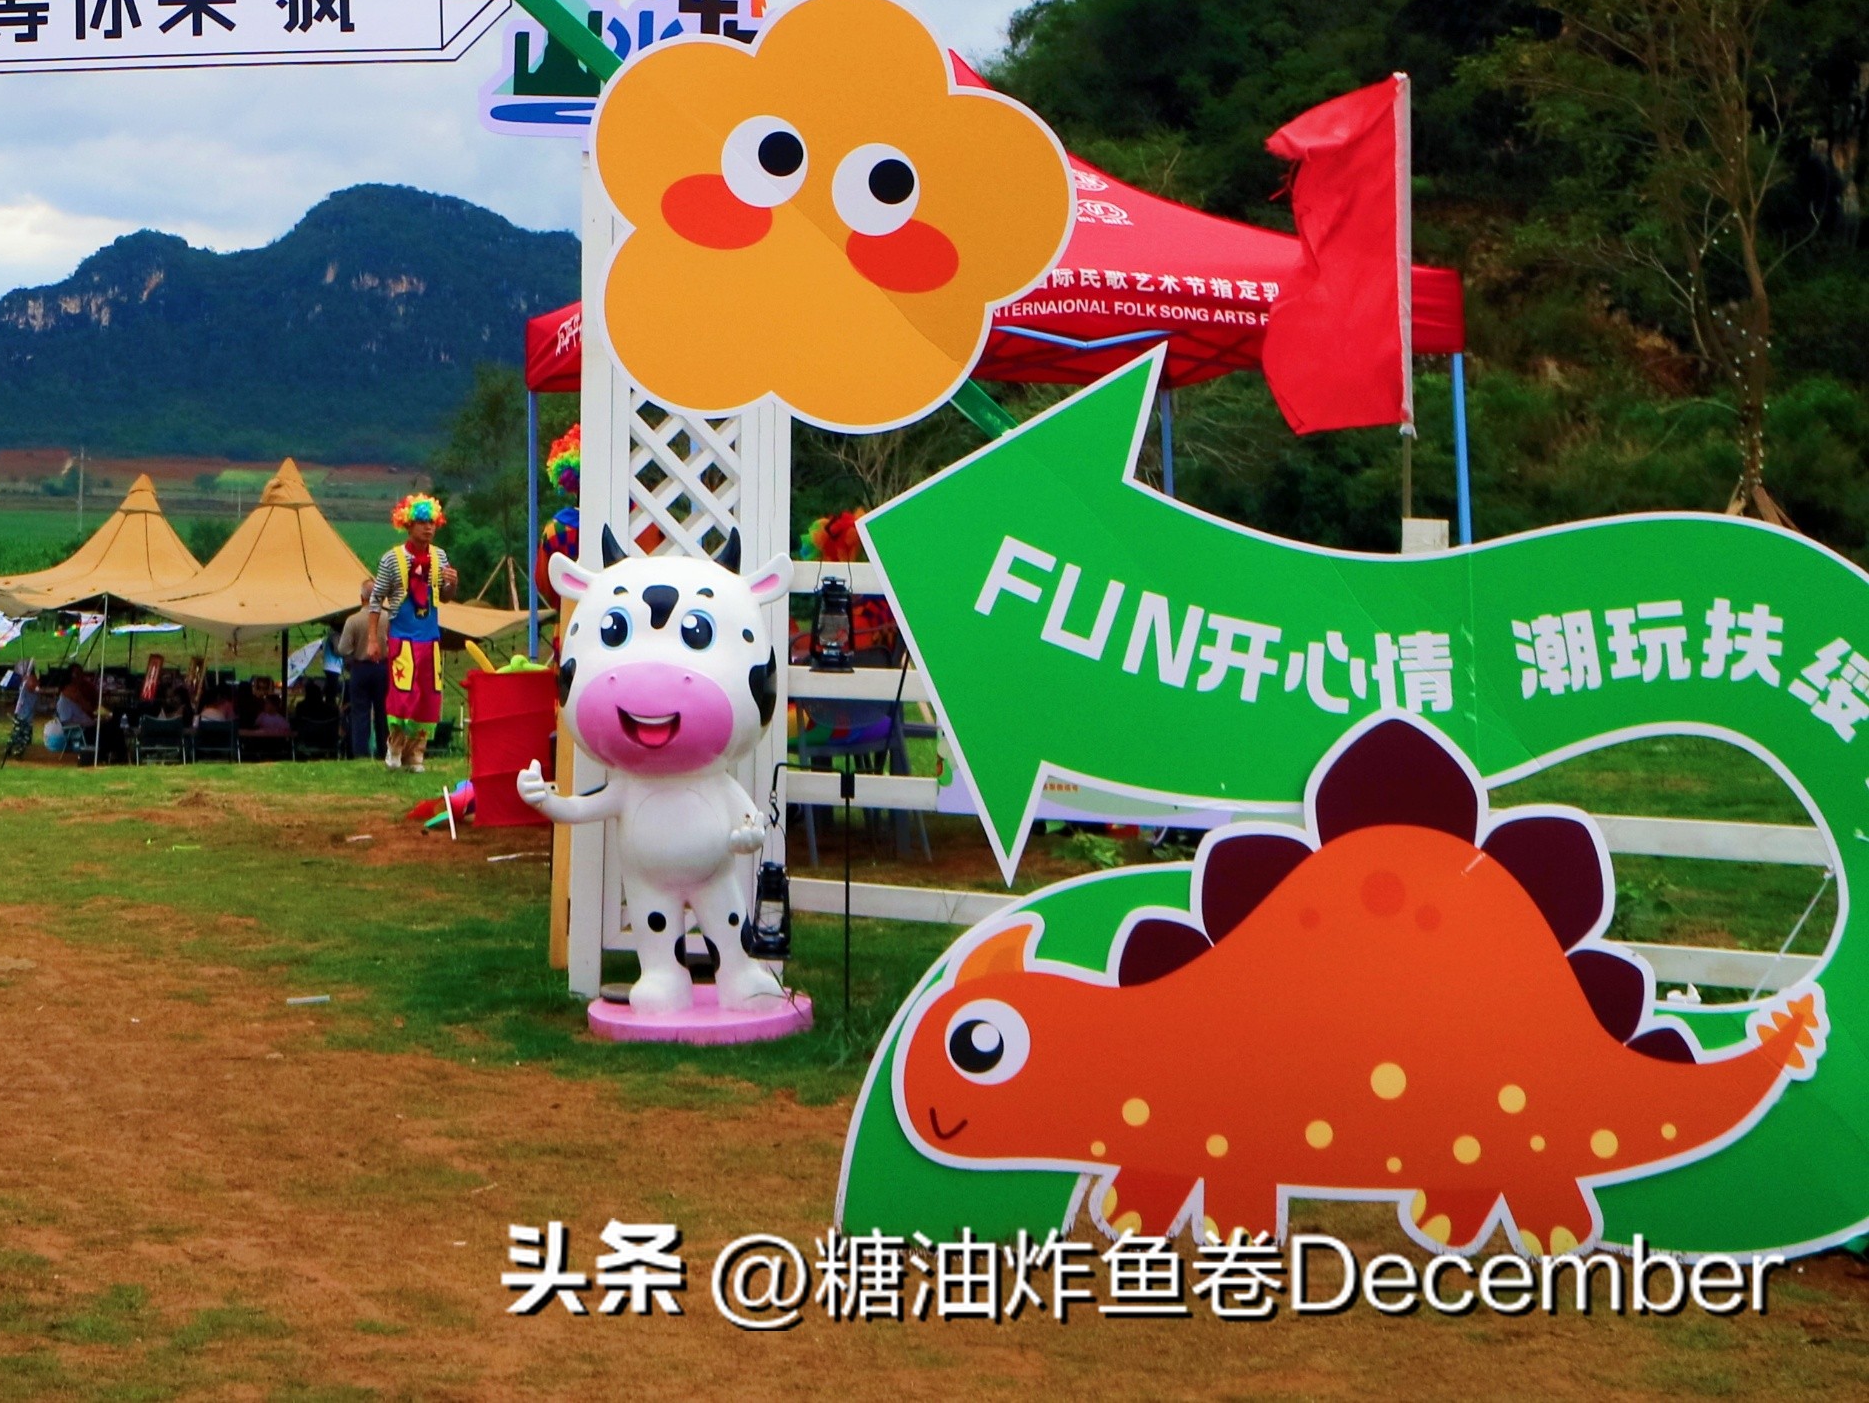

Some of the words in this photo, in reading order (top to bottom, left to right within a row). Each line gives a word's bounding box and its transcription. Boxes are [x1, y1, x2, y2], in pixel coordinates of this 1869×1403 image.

[1114, 301, 1157, 318] FOLK
[1159, 305, 1209, 321] SONG
[1213, 309, 1257, 325] ARTS
[1510, 598, 1869, 743] 潮玩扶绥
